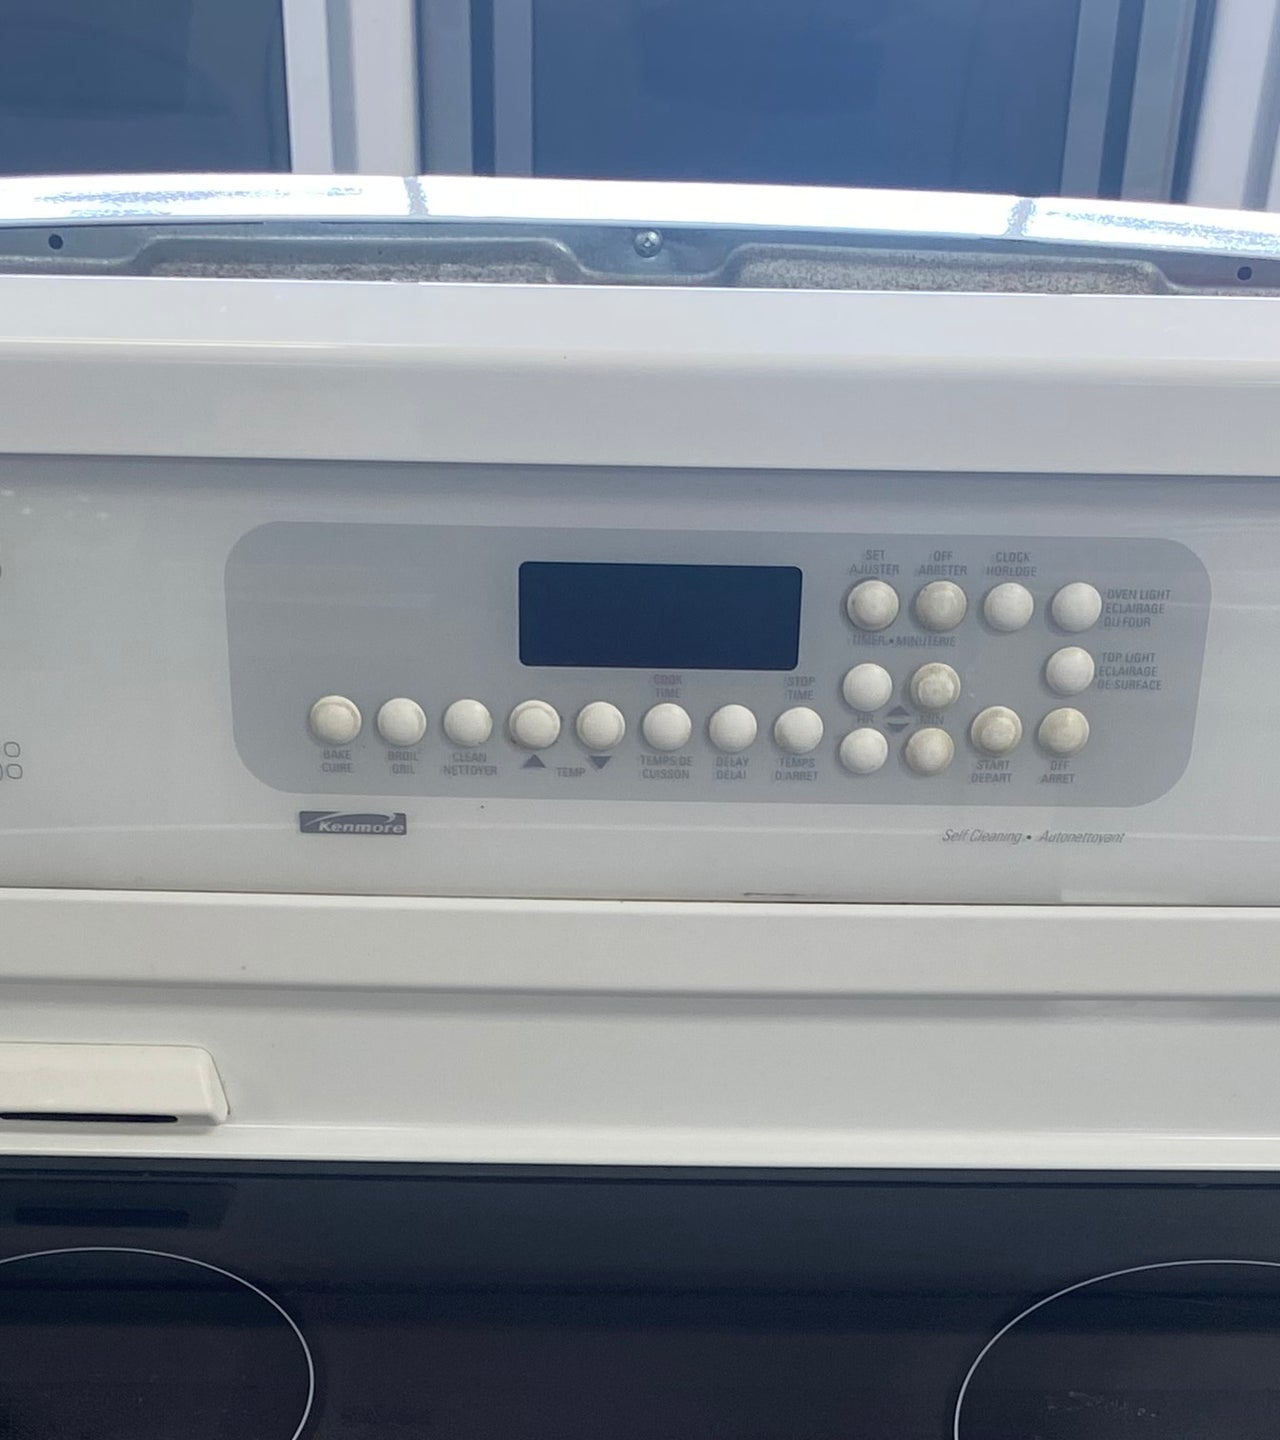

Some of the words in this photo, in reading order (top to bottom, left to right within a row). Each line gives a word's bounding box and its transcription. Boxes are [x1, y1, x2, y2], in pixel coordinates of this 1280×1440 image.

[933, 551, 953, 562] OFF
[995, 552, 1030, 563] CLOCK
[1107, 589, 1137, 600] OVEN
[1140, 589, 1171, 600] LIGHT
[1105, 603, 1165, 614] ECLAIRAGE
[1104, 616, 1120, 627] DU
[1122, 617, 1151, 628] FOUR
[1102, 652, 1122, 662] TOP
[1125, 652, 1156, 663] LIGHT
[1098, 666, 1158, 677] ECLAIRAGE
[786, 676, 816, 687] STOP
[788, 690, 814, 700] TIME
[323, 750, 352, 760] BAKE
[388, 751, 419, 761] BROIL
[452, 752, 487, 763] CLEAN
[640, 755, 676, 766] TEMPS
[716, 756, 749, 767] DELAY
[780, 757, 815, 769] TEMPS
[976, 760, 1010, 770] START
[443, 765, 498, 776] NETTOYER
[557, 767, 585, 777] TEMP
[642, 769, 690, 779] CUISSON
[971, 773, 1012, 783] DEPART
[1040, 773, 1076, 784] ARRET
[319, 822, 404, 833] Kenmore
[942, 829, 968, 842] Self
[970, 829, 1023, 845] Cleaning
[1038, 830, 1126, 844] Autonettoyant
